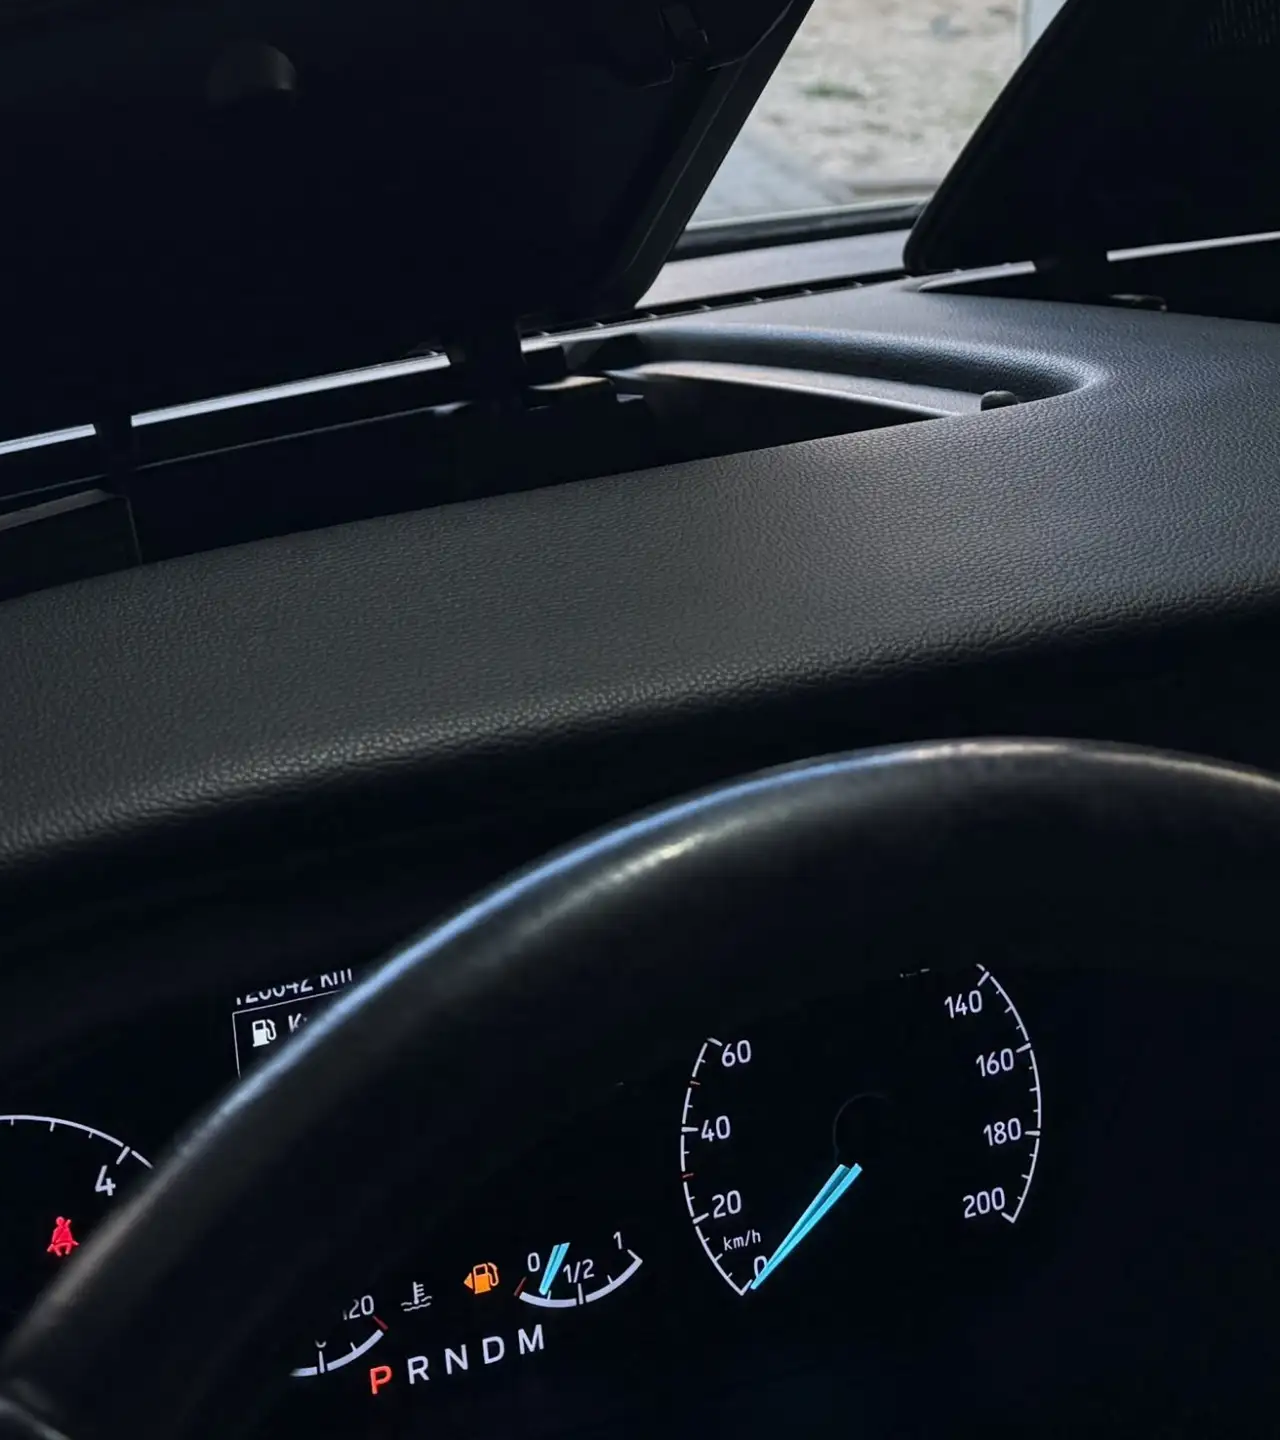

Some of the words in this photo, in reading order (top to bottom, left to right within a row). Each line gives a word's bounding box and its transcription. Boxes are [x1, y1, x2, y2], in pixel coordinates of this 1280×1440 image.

[944, 989, 983, 1019] 140
[721, 1039, 752, 1067] 60
[976, 1047, 1015, 1077] 160
[701, 1115, 731, 1142] 40
[983, 1117, 1022, 1147] 180
[94, 1164, 117, 1196] 4
[711, 1190, 743, 1219] 20
[962, 1187, 1006, 1219] 200
[613, 1231, 623, 1250] 1
[723, 1229, 762, 1252] km/h
[527, 1252, 541, 1273] 0
[562, 1259, 595, 1284] 1/2
[369, 1365, 392, 1395] P
[407, 1355, 430, 1385] R
[444, 1344, 469, 1375] N
[482, 1335, 506, 1365] D
[517, 1324, 545, 1355] M
